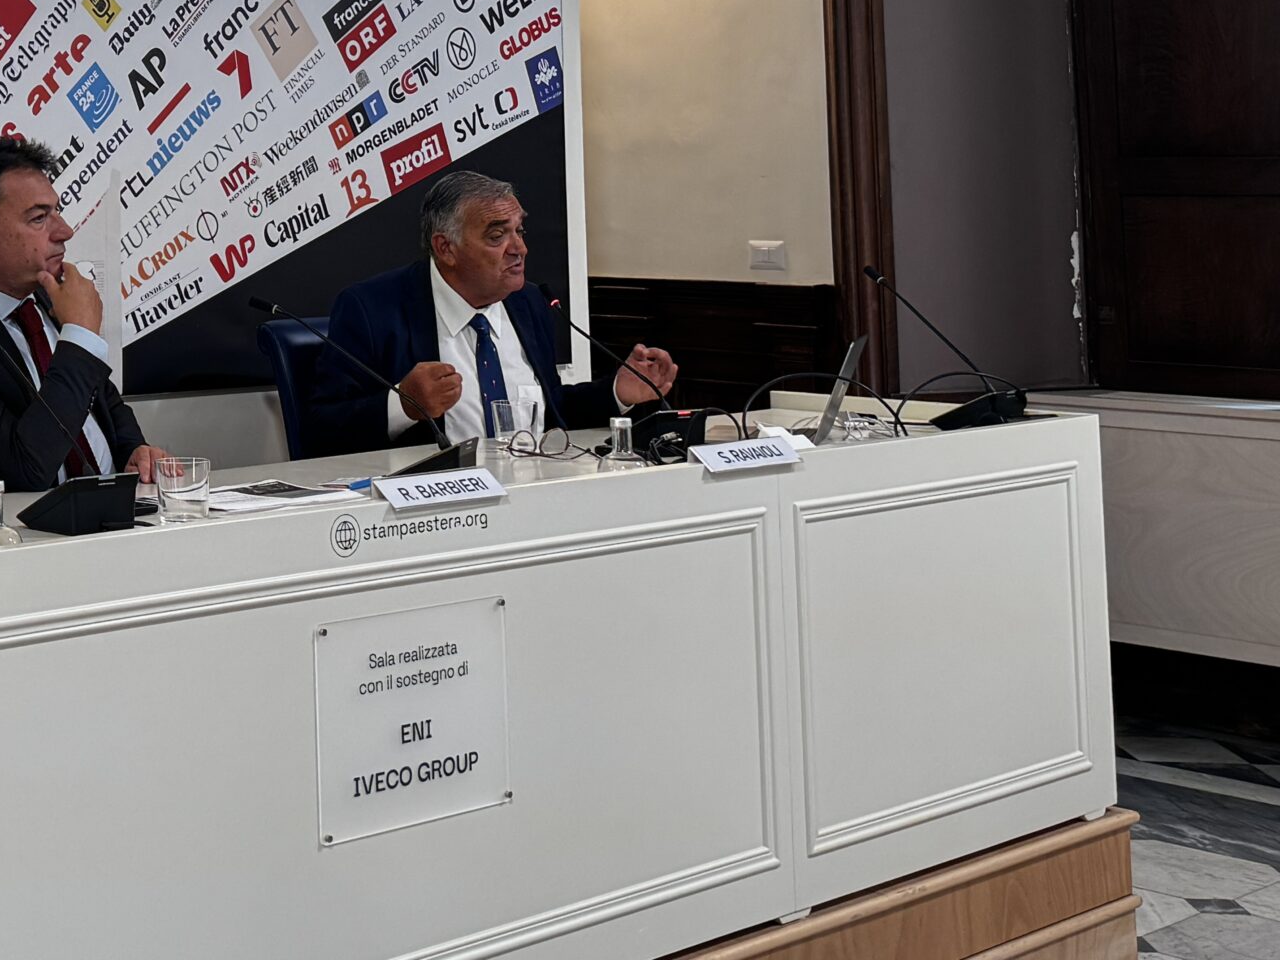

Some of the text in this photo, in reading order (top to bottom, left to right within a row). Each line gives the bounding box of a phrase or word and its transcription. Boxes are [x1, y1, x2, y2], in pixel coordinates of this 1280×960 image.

[108, 3, 157, 56] Daily
[344, 13, 388, 61] ORF
[499, 6, 562, 61] GLOBUS
[26, 33, 92, 117] arte
[73, 70, 99, 102] FRANCE
[128, 47, 166, 111] AP
[284, 48, 325, 94] FINANCIAL
[290, 75, 316, 105] TIMES
[388, 48, 440, 104] CCTV
[447, 59, 500, 104] MONOCLE
[78, 91, 95, 113] 24
[262, 82, 360, 166] Weekendavisen
[345, 98, 439, 164] MORGENBLADET
[390, 134, 443, 186] profil
[228, 175, 260, 204] NOTIMEX
[263, 194, 331, 248] Capital
[397, 476, 489, 503] R. BARBIERI
[363, 513, 488, 540] stampaestera.org
[359, 661, 469, 695] con il sostegno di
[369, 642, 458, 669] Sala realizzata
[401, 719, 433, 744] ENI
[353, 751, 479, 798] IVECO GROUP
